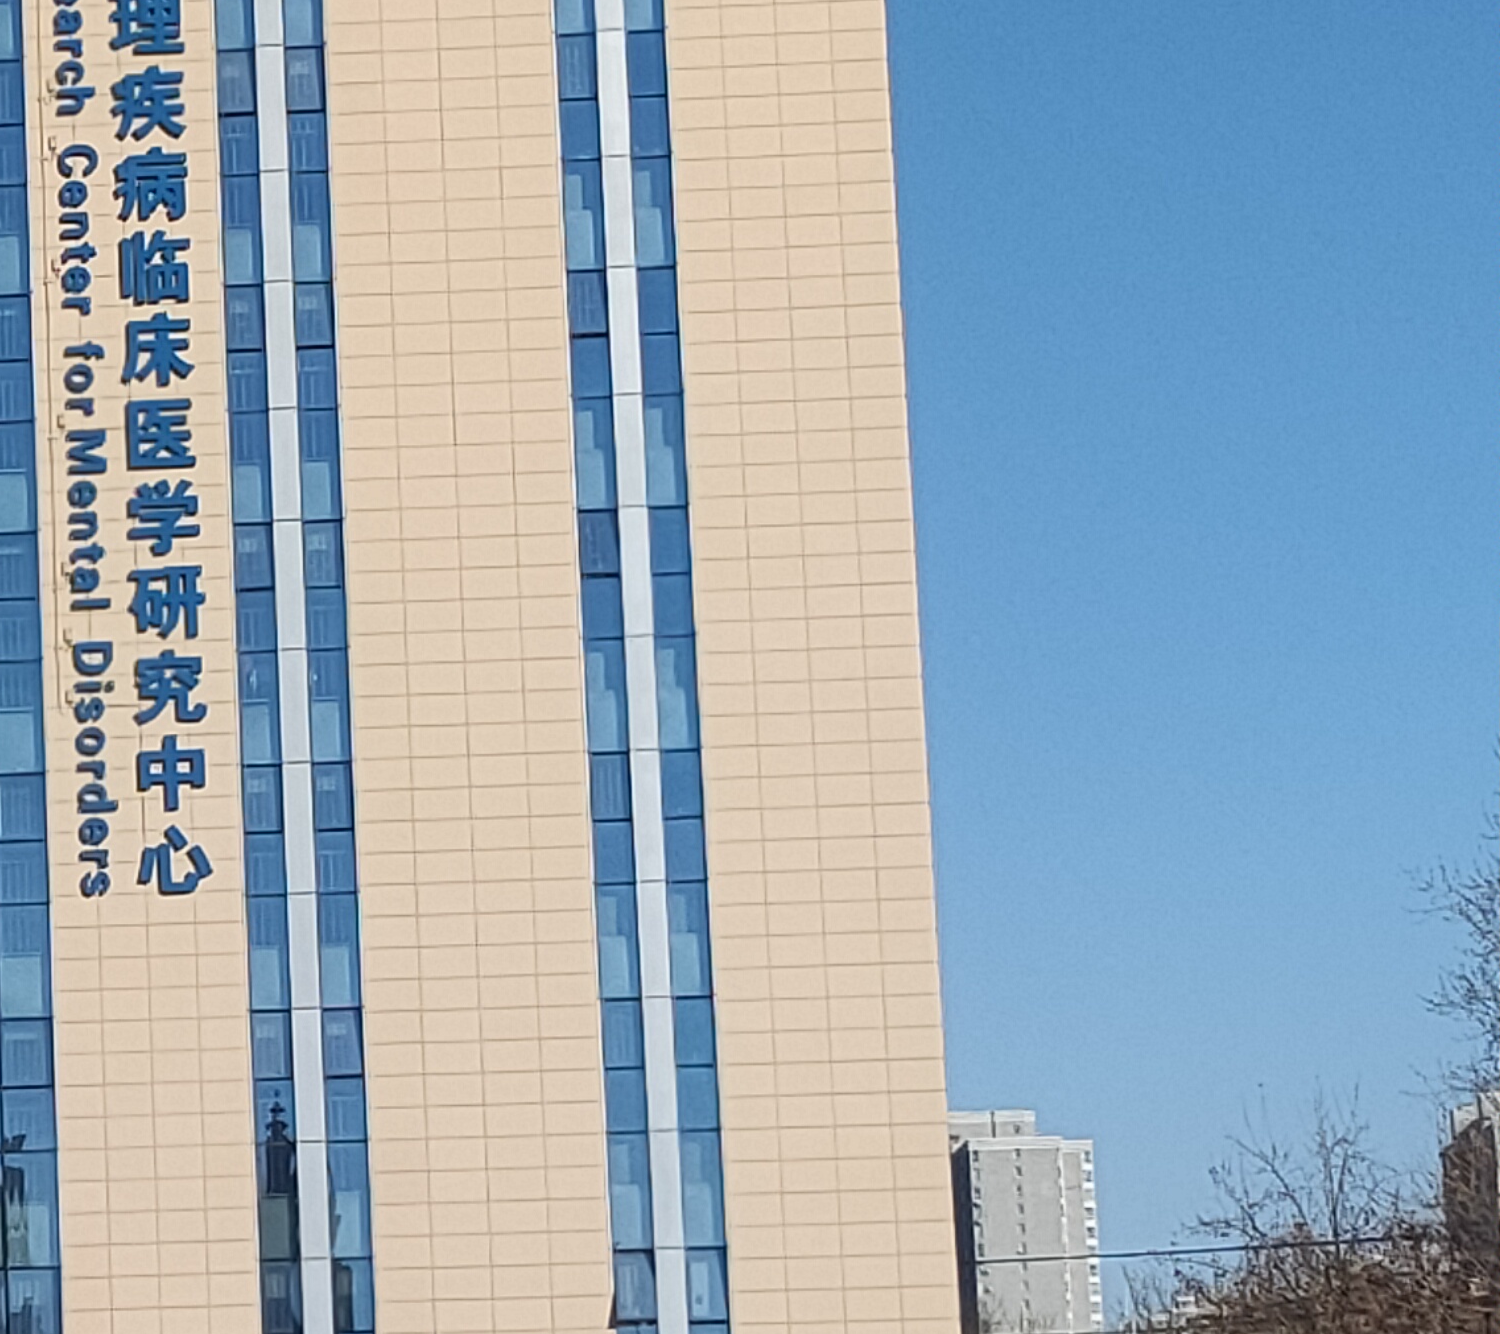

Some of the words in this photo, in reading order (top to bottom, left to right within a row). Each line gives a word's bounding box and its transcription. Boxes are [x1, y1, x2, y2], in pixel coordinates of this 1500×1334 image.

[56, 143, 100, 317] Center
[63, 341, 107, 417] for
[66, 429, 112, 611] Mental
[72, 639, 119, 898] Disorders
